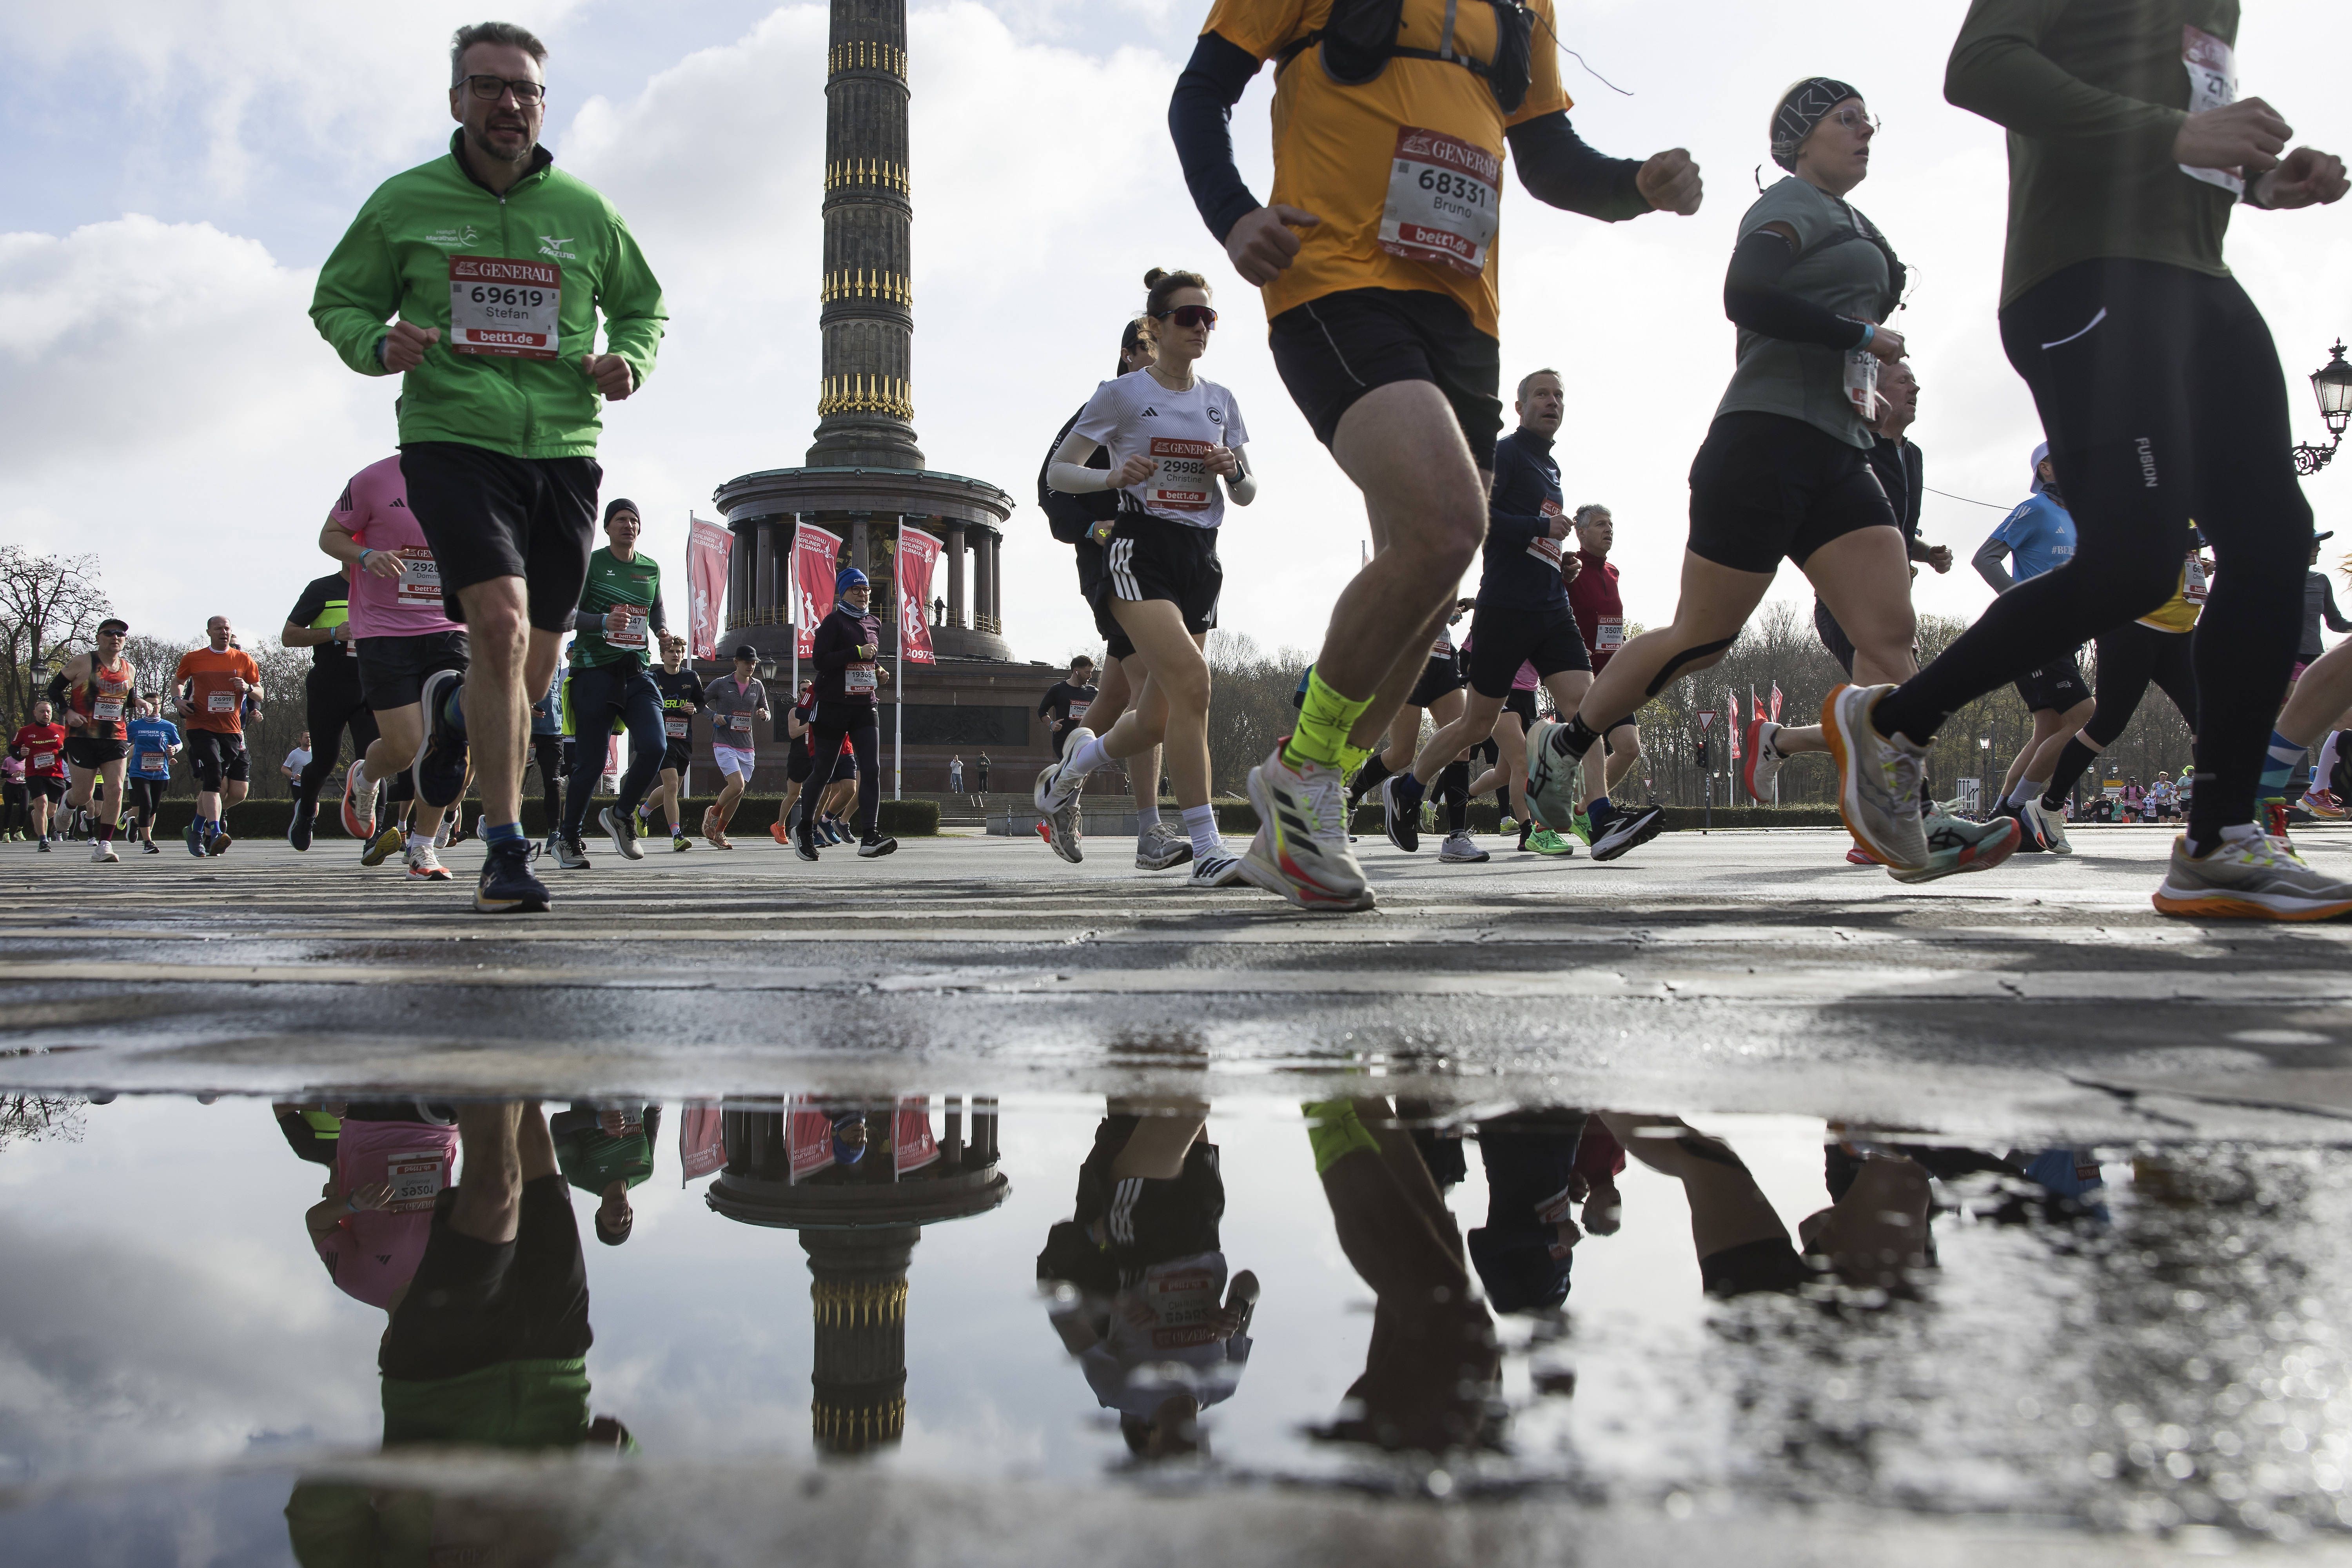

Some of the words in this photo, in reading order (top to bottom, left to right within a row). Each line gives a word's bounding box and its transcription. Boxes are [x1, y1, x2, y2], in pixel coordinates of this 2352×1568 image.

[1419, 169, 1486, 208] 68331
[1434, 196, 1472, 218] Bruno
[1416, 227, 1468, 254] bett1.de
[480, 263, 554, 282] GENERALI
[471, 286, 543, 307] 69619
[486, 306, 529, 319] Stefan
[480, 331, 534, 344] bett1.de
[1163, 460, 1205, 475] 29982
[2134, 437, 2158, 487] FUSION
[1166, 474, 1202, 483] Christine
[1166, 492, 1199, 500] bett1.de
[699, 529, 720, 539] GENERALI
[805, 534, 827, 544] GENERALI
[908, 537, 929, 548] GENERALI
[1542, 540, 1559, 555] bett1.de
[412, 562, 439, 573] 2920
[695, 644, 711, 656] .0975
